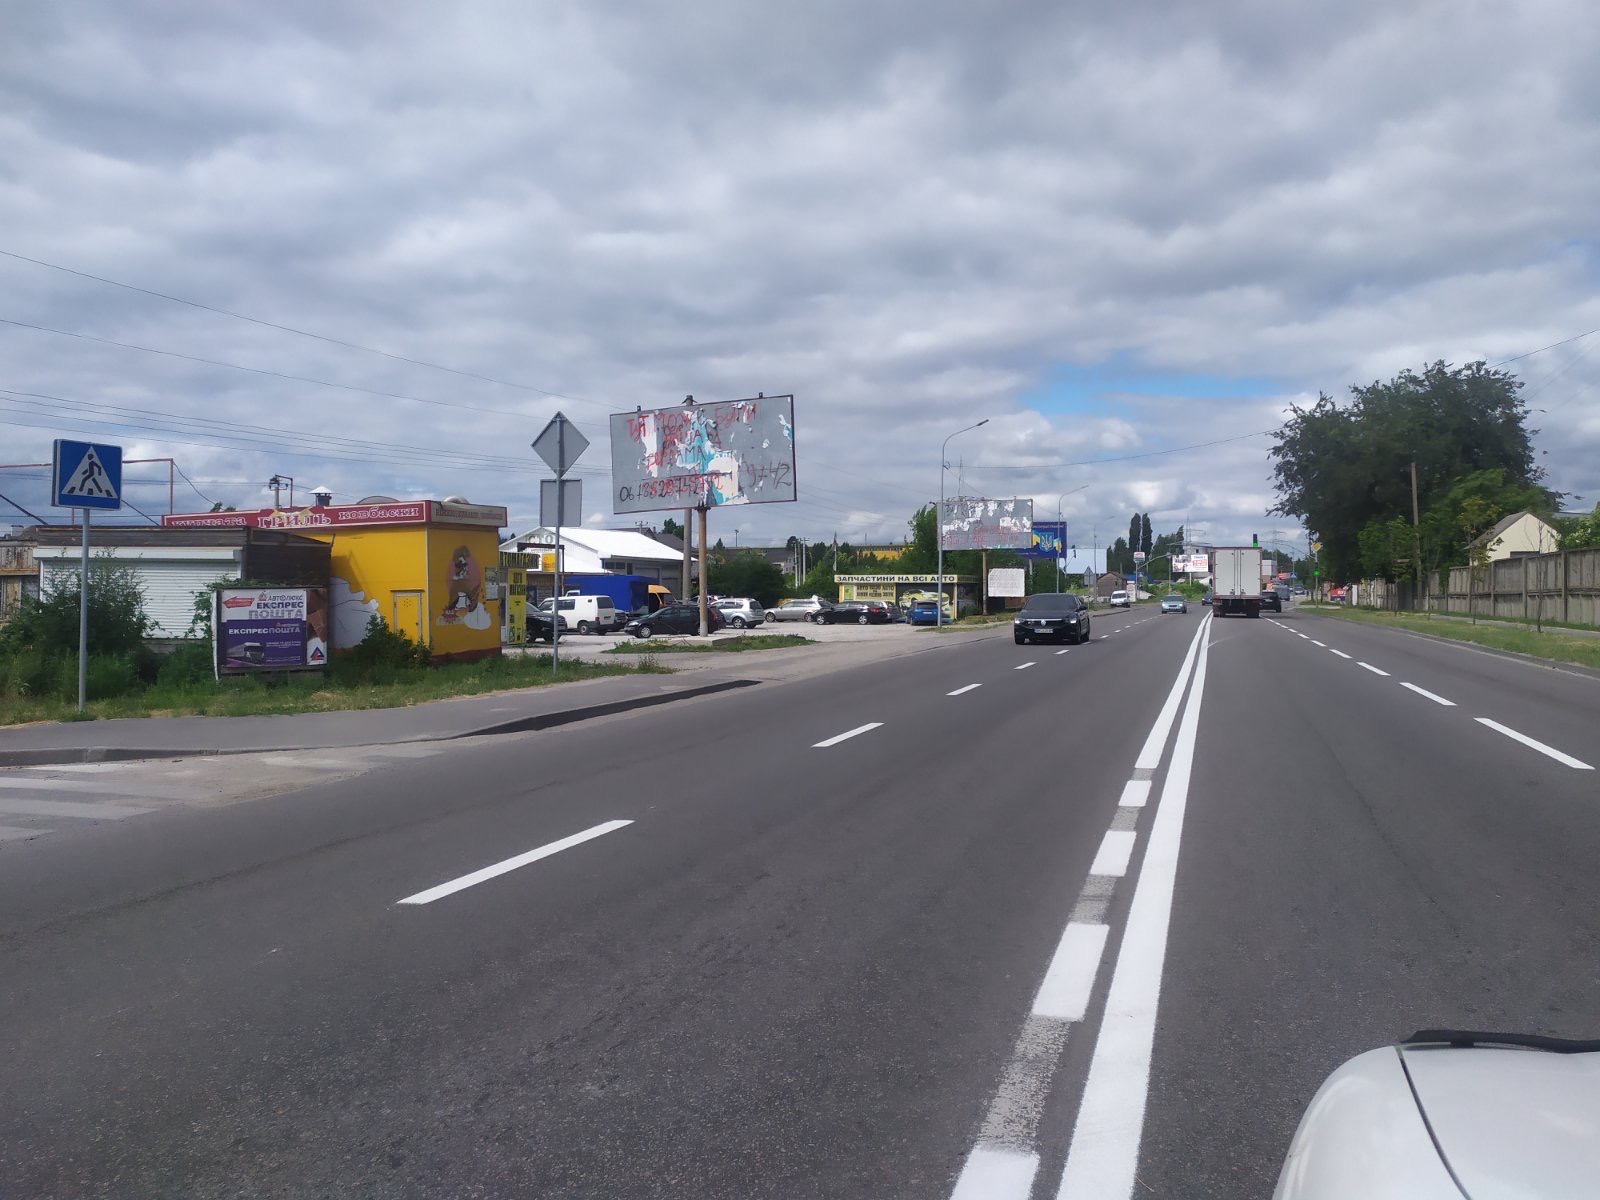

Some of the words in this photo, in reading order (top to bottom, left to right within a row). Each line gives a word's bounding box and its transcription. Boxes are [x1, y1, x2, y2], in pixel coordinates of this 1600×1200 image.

[257, 512, 332, 528] ГРИЛЬ
[338, 505, 419, 520] ковбаски
[256, 601, 304, 609] ЕКСПРЕС
[248, 609, 304, 619] ПОШТА
[228, 626, 301, 635] ЕКСПРЕСПОШТА
